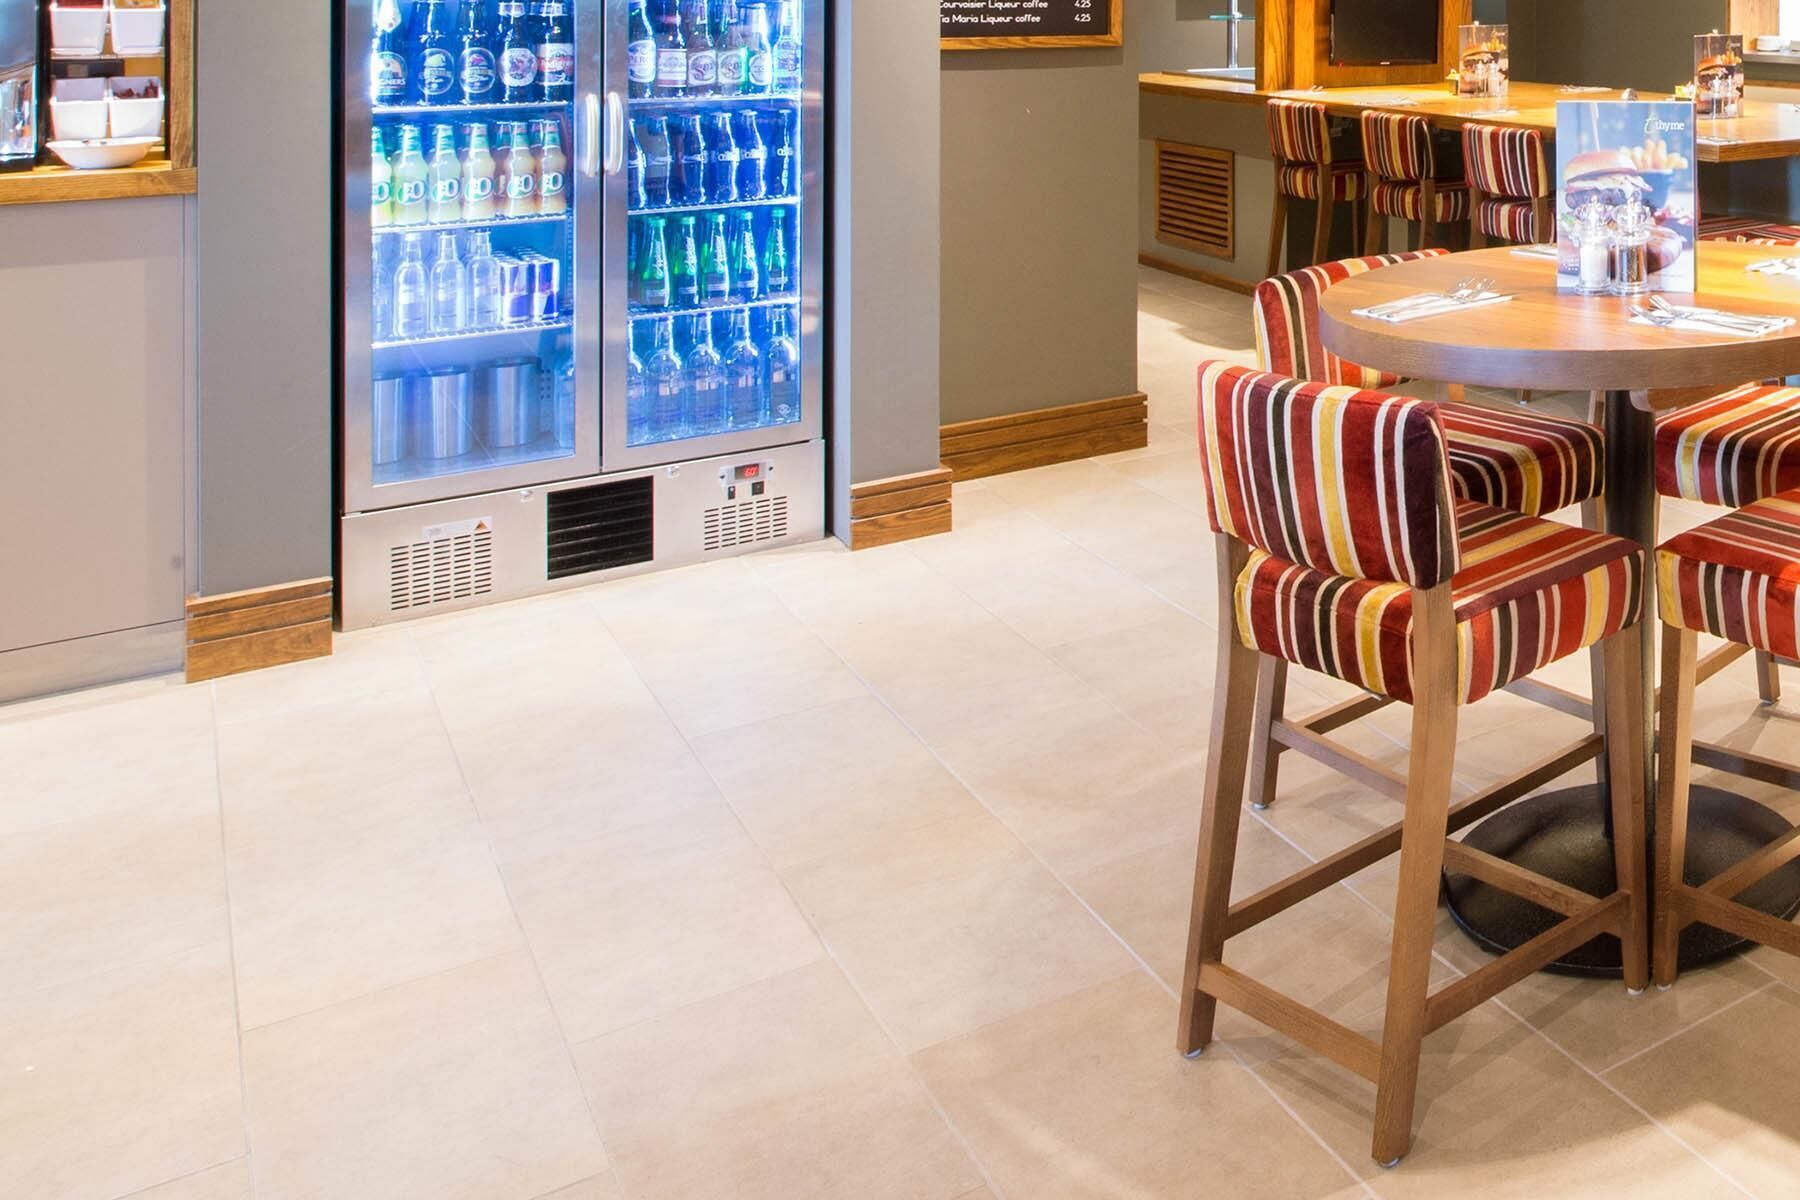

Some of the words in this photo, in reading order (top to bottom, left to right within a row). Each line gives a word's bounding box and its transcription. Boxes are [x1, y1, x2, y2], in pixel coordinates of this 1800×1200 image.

[988, 0, 1020, 10] Liqueur
[1023, 0, 1048, 8] coffee
[952, 14, 979, 23] Maria
[981, 15, 1012, 25] Liqueur
[1015, 14, 1041, 23] coffee
[1656, 120, 1684, 132] thyme
